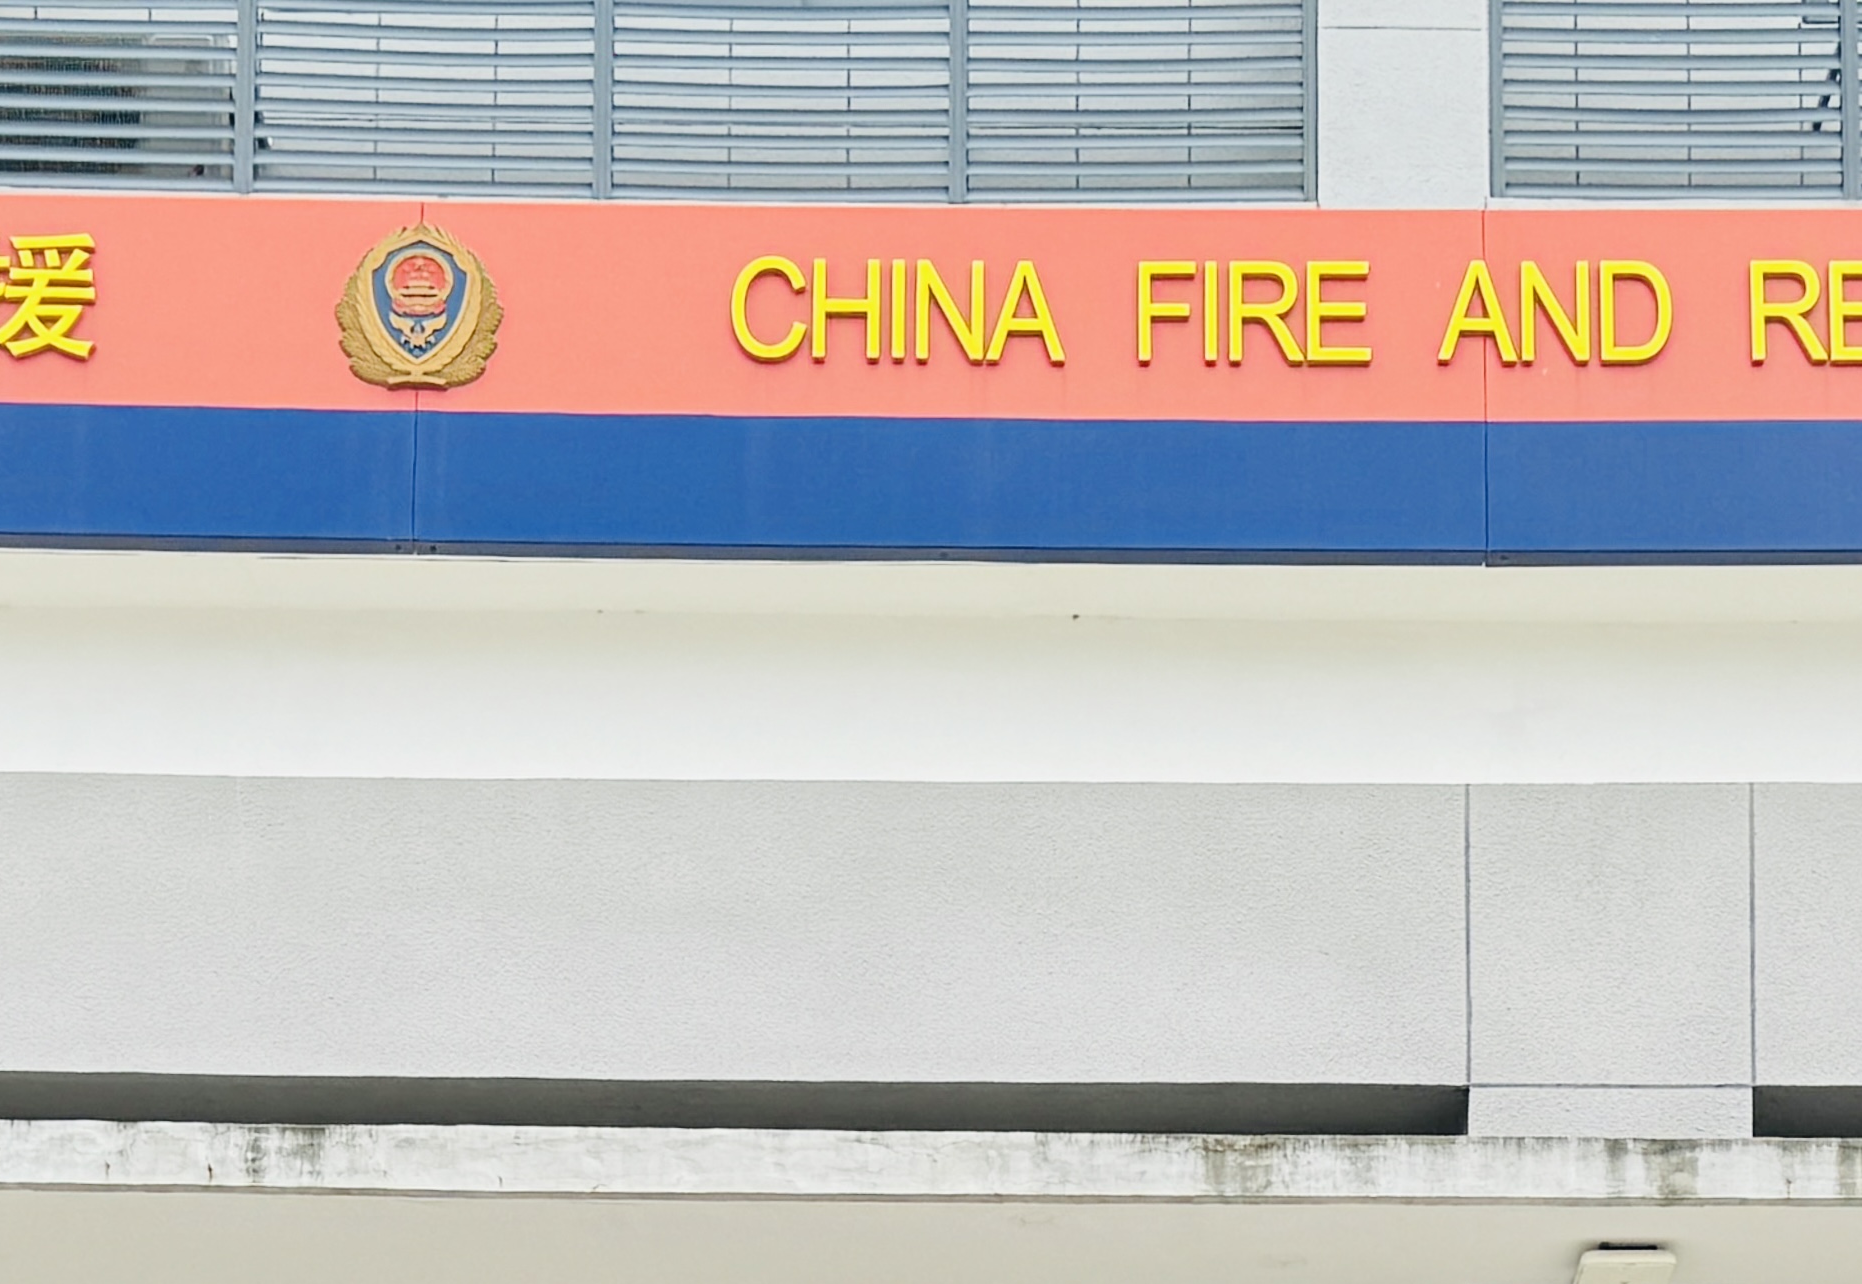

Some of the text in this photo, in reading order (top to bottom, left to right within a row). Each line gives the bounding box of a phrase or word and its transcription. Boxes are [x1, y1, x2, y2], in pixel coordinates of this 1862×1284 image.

[730, 254, 1066, 367] CHINA
[1134, 256, 1374, 368] FIRE
[1437, 257, 1675, 368] AND
